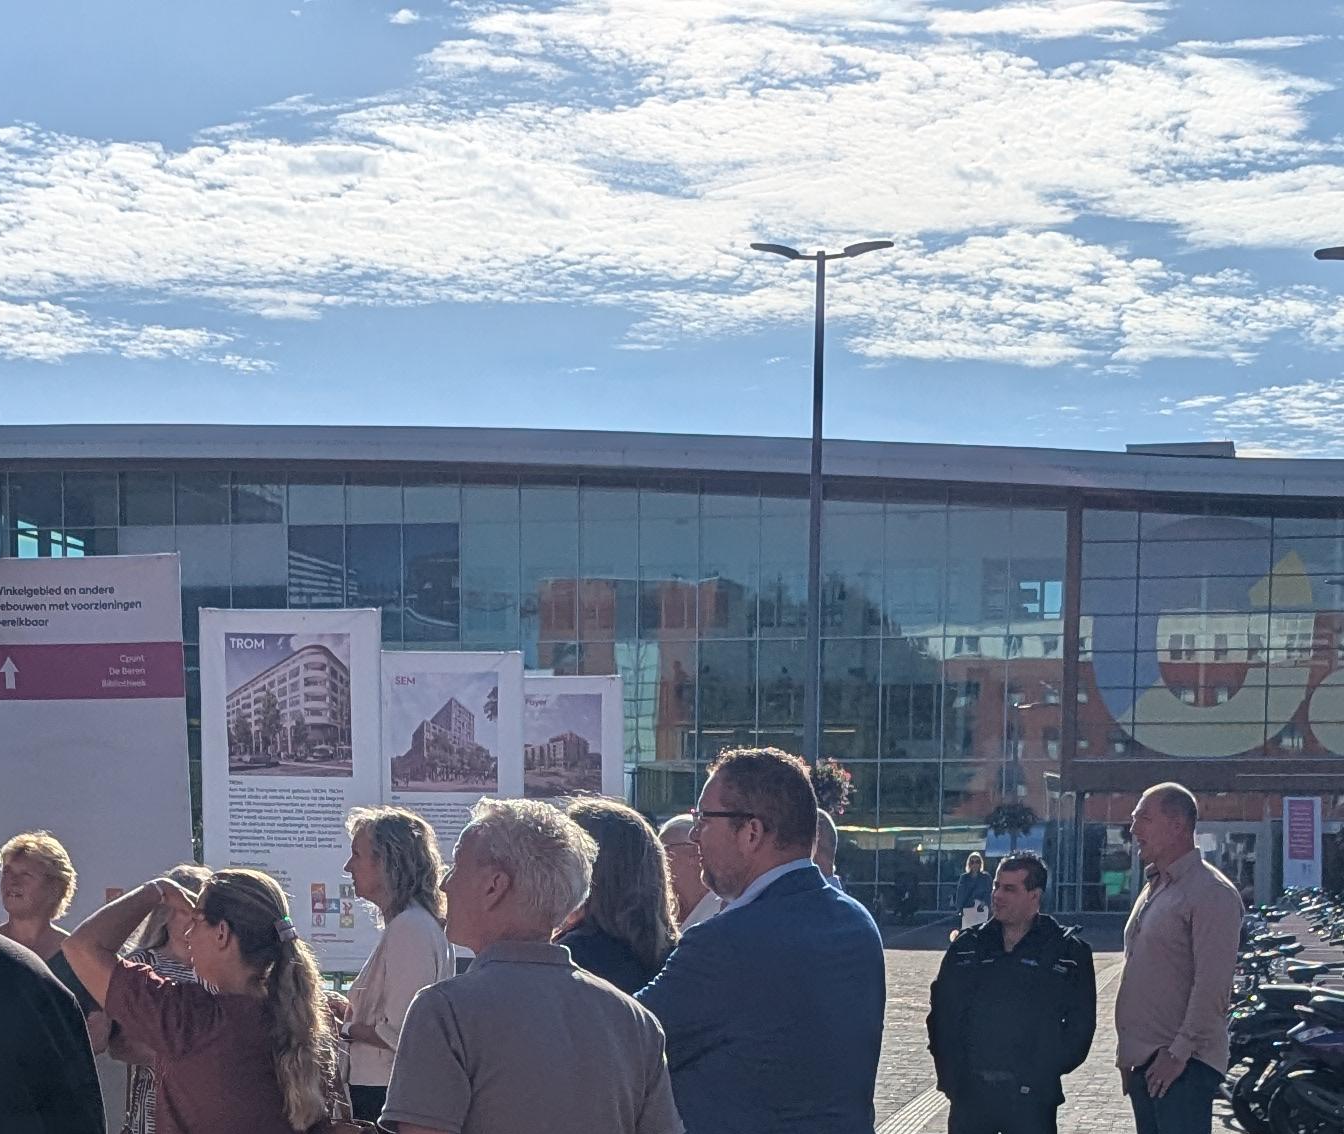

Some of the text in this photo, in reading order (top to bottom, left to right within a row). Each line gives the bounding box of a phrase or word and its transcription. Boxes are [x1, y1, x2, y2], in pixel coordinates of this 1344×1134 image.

[63, 587, 77, 596] en
[78, 585, 115, 595] andere
[48, 601, 70, 611] met
[70, 599, 143, 612] voorzieningen
[229, 637, 265, 650] TROM
[394, 676, 416, 686] SEM
